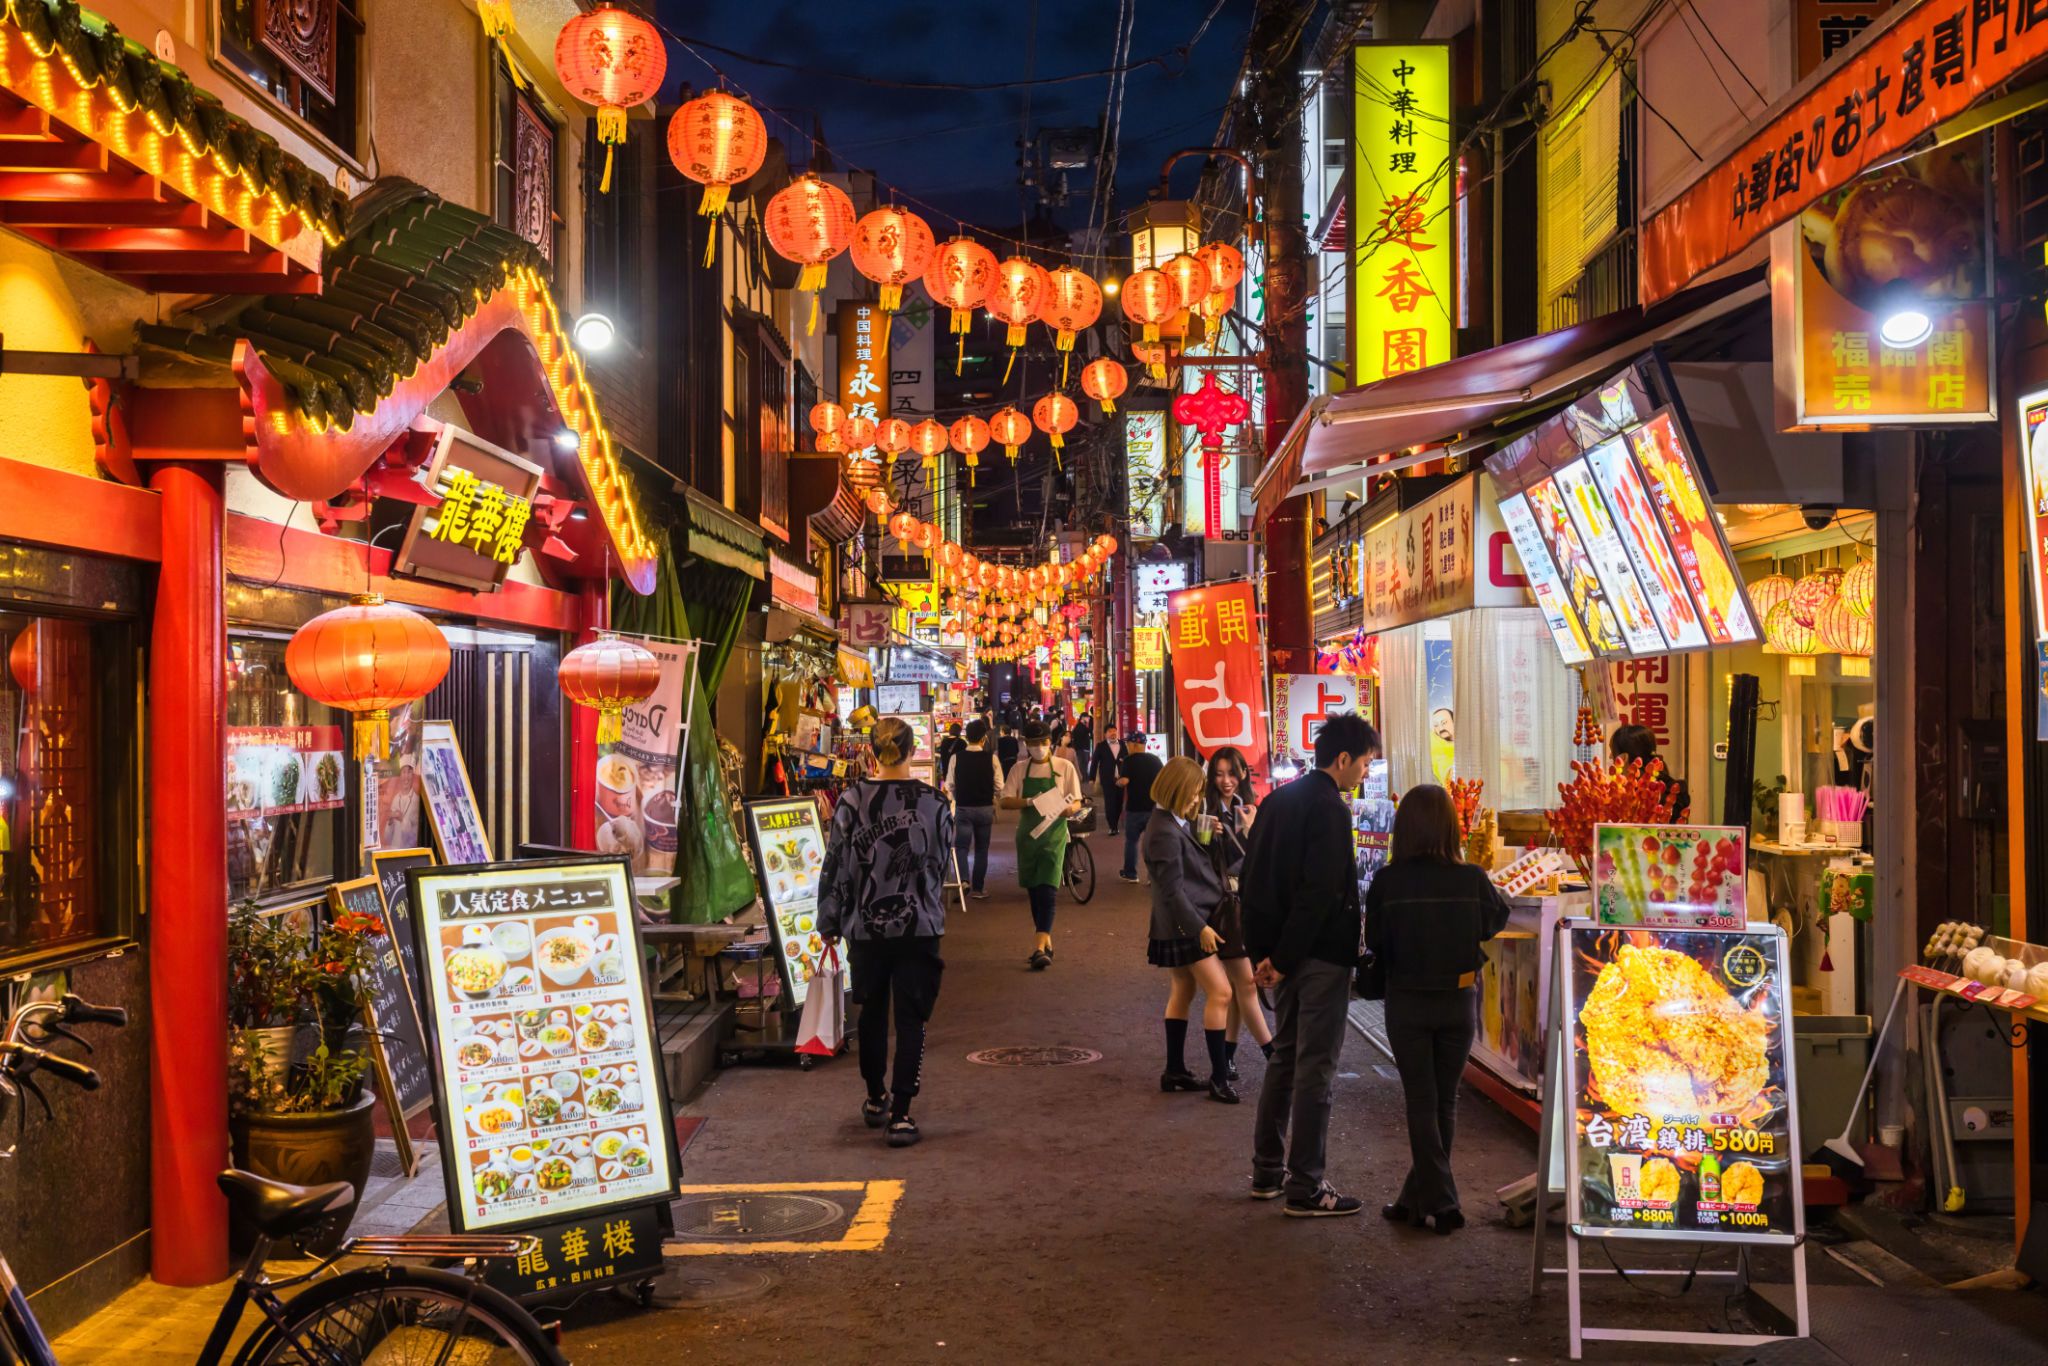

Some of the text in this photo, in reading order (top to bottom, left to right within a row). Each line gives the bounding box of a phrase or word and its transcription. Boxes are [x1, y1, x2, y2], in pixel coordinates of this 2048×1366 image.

[1388, 59, 1418, 174] 中華料理
[1375, 191, 1437, 377] 蓮香園
[857, 306, 873, 361] 中国料理
[1833, 373, 1966, 410] 売店
[855, 608, 890, 643] 占
[1275, 677, 1288, 756] 実力派の先生
[450, 888, 605, 916] 人気定食メニュー
[1586, 1113, 1652, 1151] 台湾
[1663, 1114, 1699, 1124] ジーパイ
[1658, 1128, 1707, 1152] 鶏排
[1713, 1129, 1774, 1153] 580円
[1642, 1210, 1674, 1223] 880円
[1729, 1213, 1768, 1227] 1000円
[536, 1264, 615, 1290] 広東・四川料理
